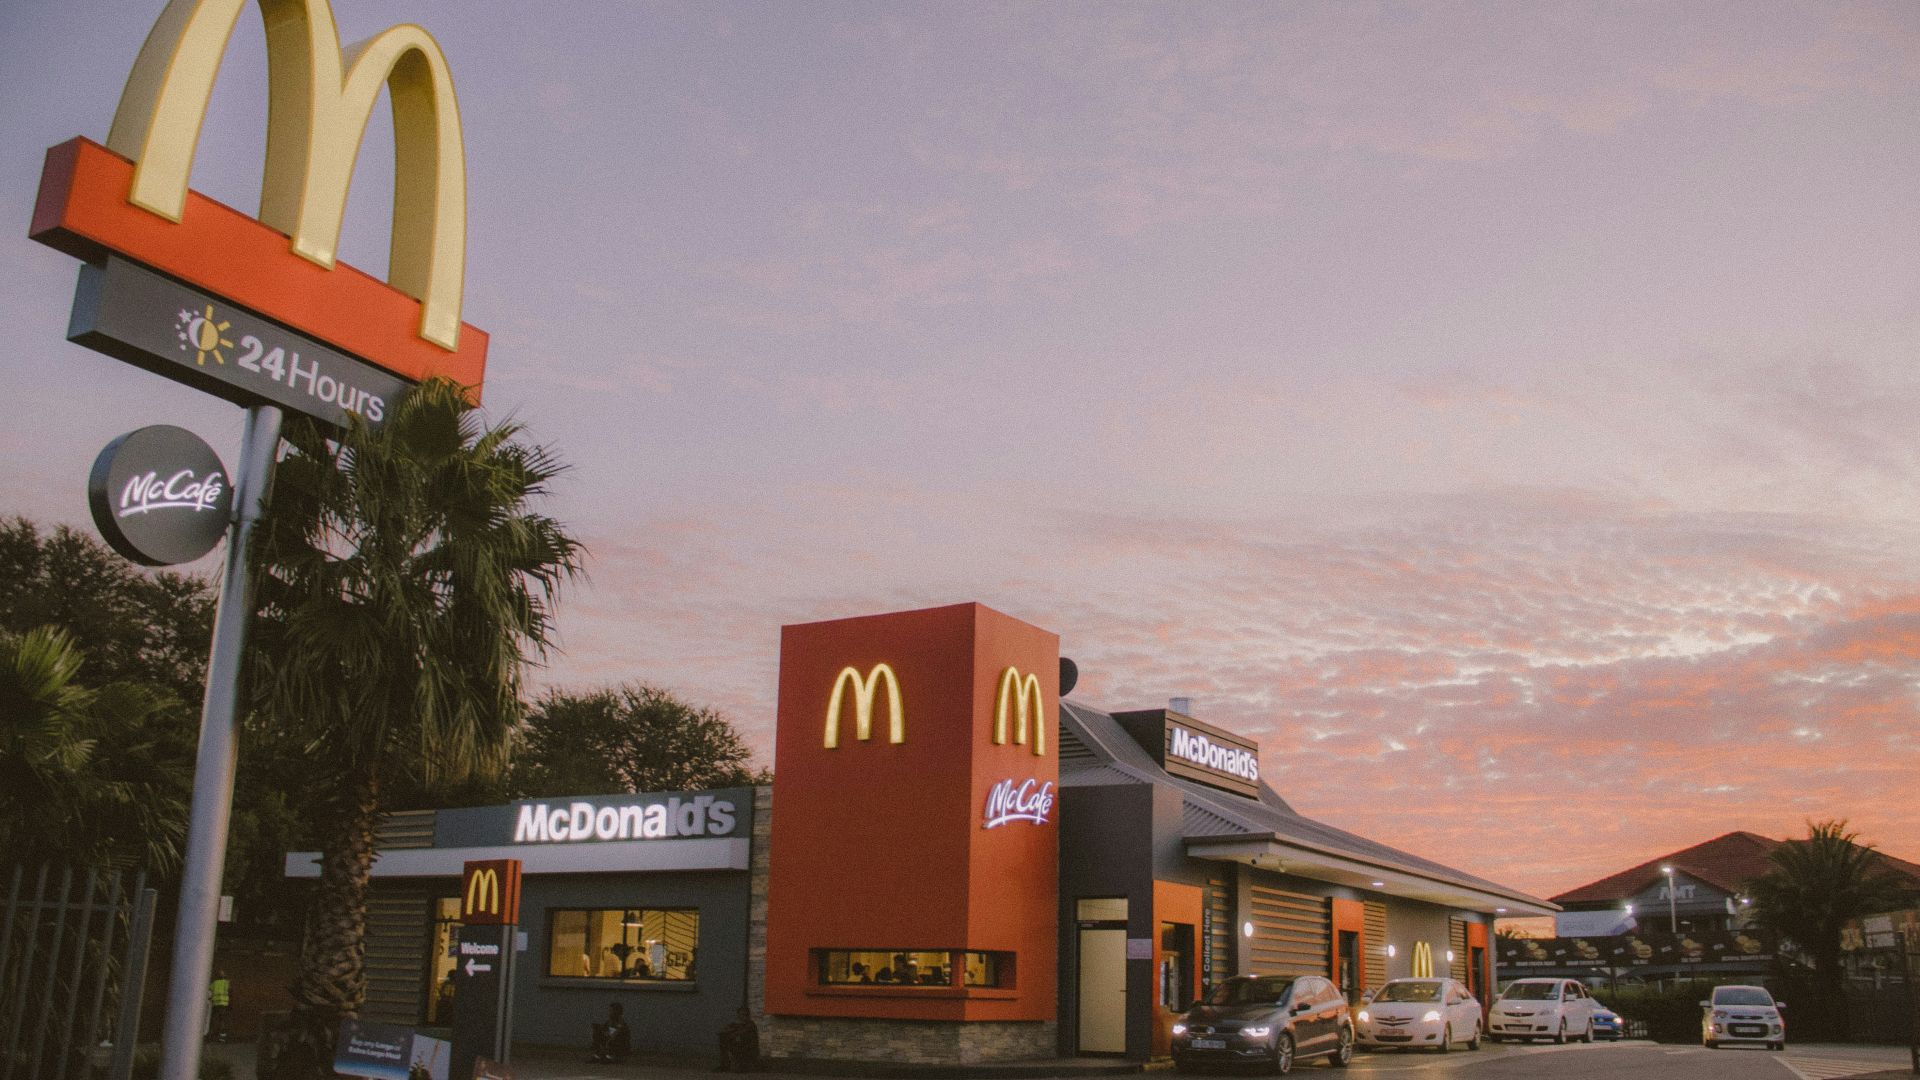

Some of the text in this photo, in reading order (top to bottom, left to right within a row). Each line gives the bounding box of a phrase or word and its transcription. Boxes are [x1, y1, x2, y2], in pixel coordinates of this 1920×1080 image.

[238, 335, 385, 422] 24 Hours
[119, 469, 223, 517] McCafé
[1169, 727, 1258, 781] McDonald's
[513, 795, 737, 842] McDonald's
[984, 778, 1053, 828] McCafé
[1203, 908, 1211, 933] Here
[461, 942, 499, 955] Welcome
[1203, 935, 1211, 972] Collect
